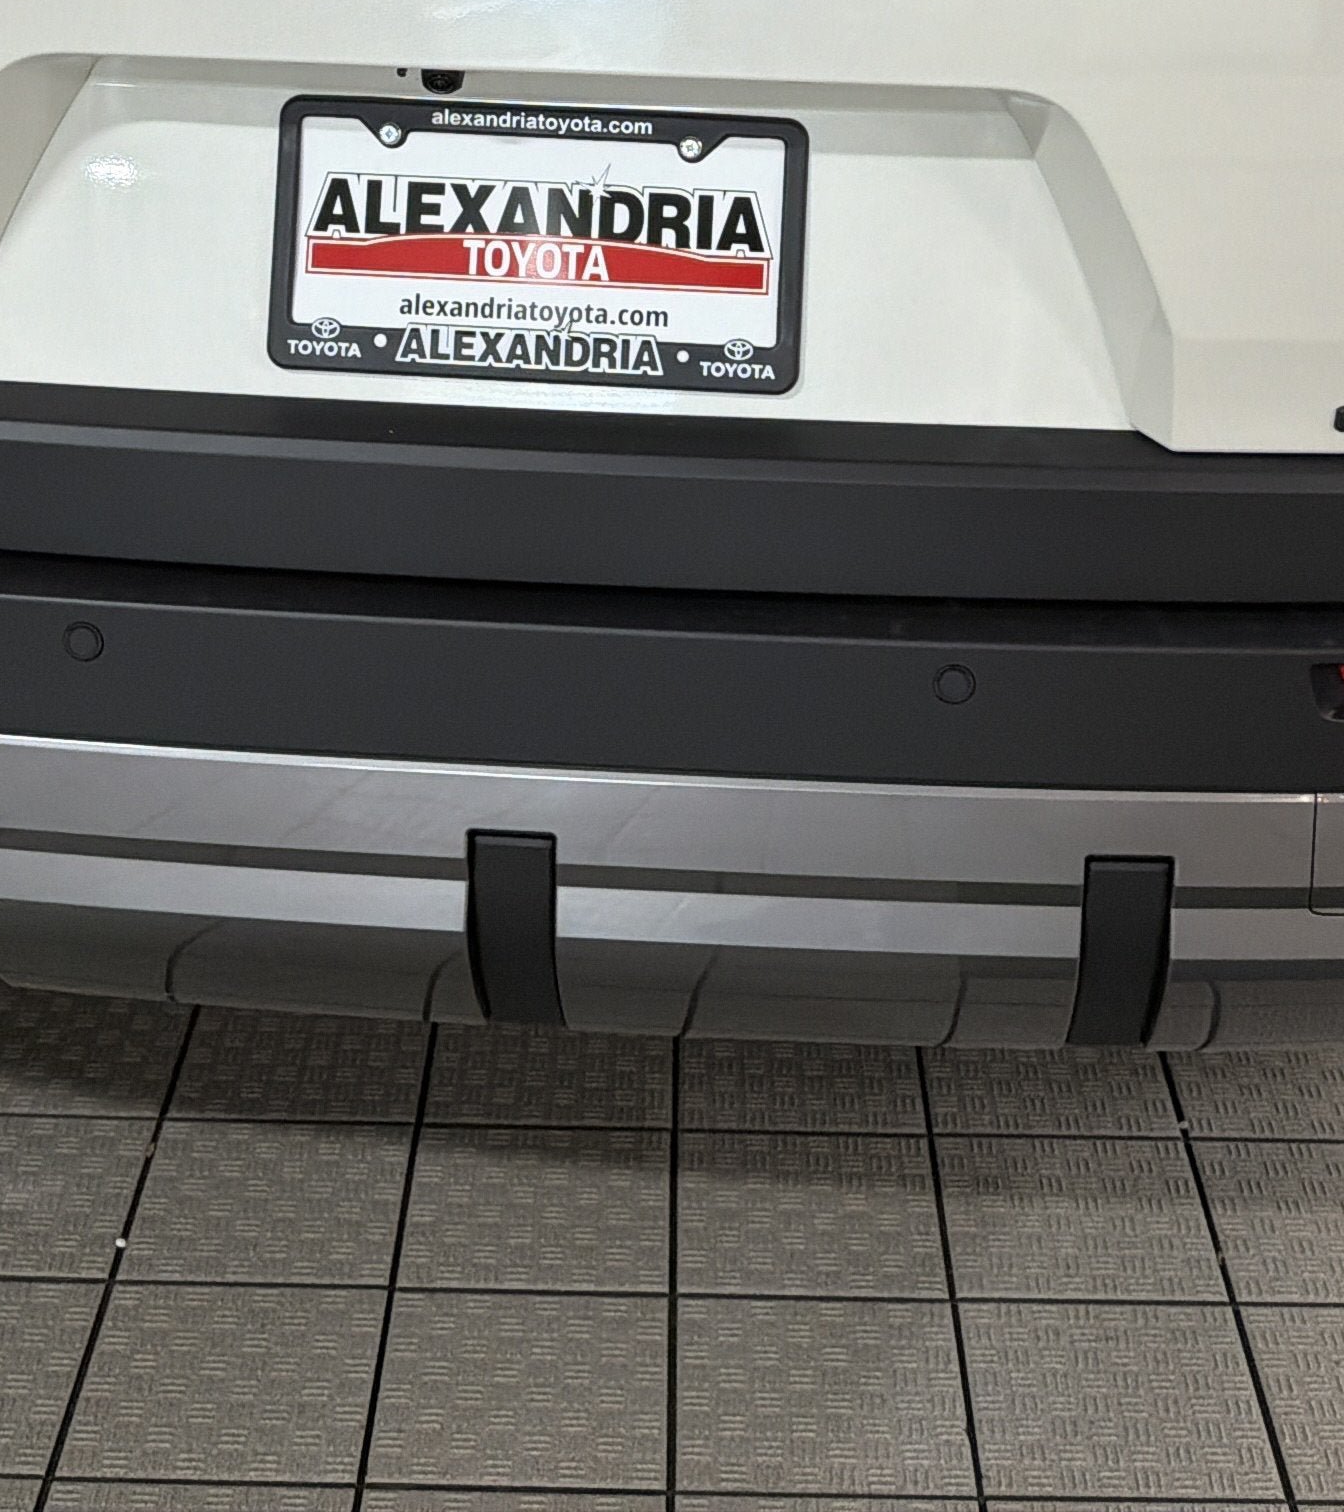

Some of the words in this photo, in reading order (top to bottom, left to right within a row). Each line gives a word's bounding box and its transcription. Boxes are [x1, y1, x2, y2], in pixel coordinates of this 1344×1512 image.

[431, 109, 654, 136] alexandriatoyota.com
[312, 176, 766, 254] ALEXANDRIA
[462, 239, 611, 283] TOYOTA
[398, 293, 669, 329] alexandriatoyota.com
[287, 338, 362, 359] TOYOTA
[399, 327, 660, 374] ALEXANDRIA
[699, 360, 776, 381] TOYOTA
